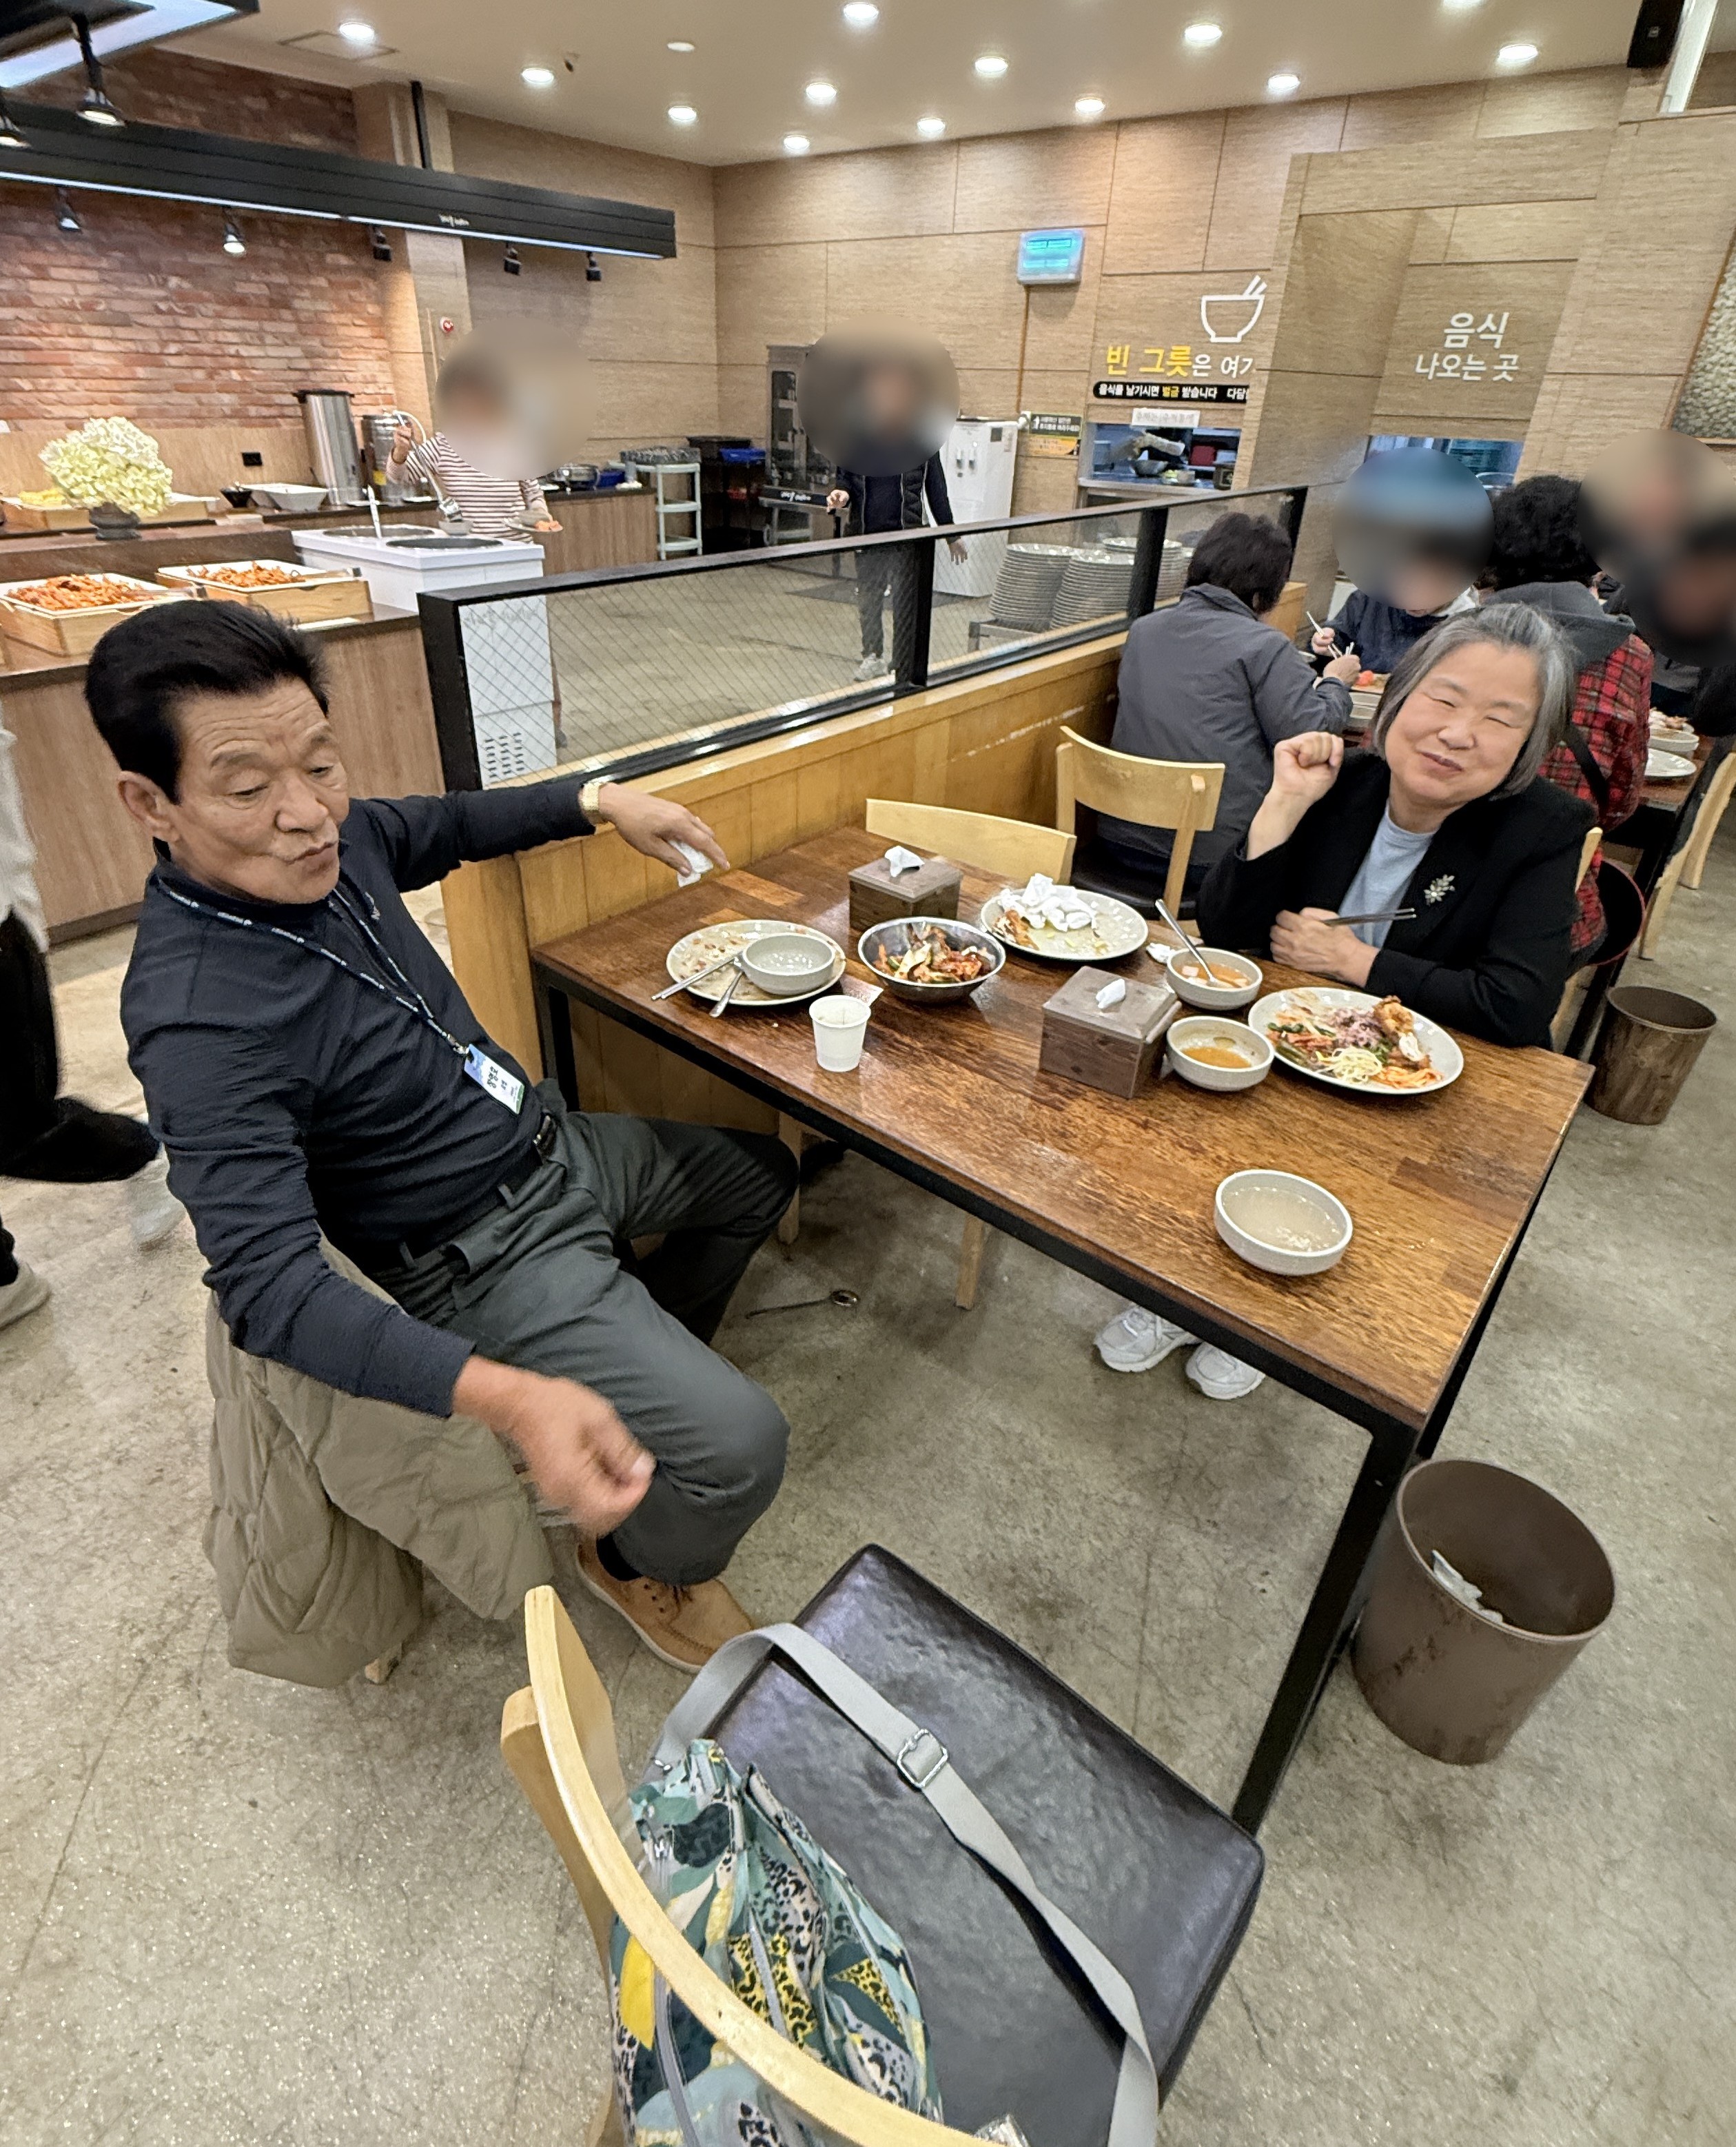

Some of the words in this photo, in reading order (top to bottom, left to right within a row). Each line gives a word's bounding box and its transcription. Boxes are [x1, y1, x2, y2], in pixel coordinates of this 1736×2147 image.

[1444, 312, 1510, 349] 음식
[1107, 345, 1130, 375] 빈
[1139, 345, 1212, 377] 그릇은
[1415, 352, 1487, 380] 나오는
[1492, 354, 1520, 382] 곳
[1126, 384, 1159, 397] 남기시면
[1182, 386, 1217, 399] 받습니다
[1227, 387, 1249, 400] 다담
